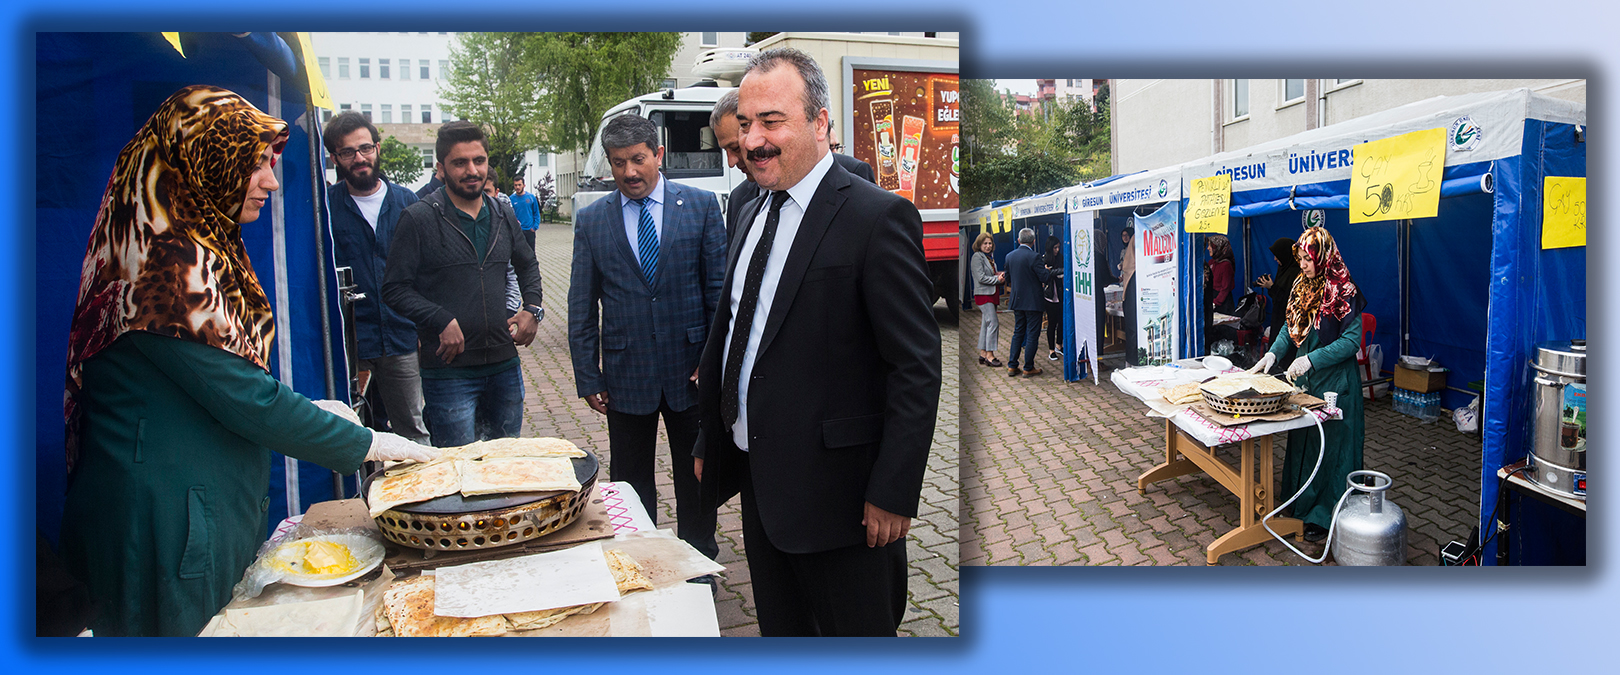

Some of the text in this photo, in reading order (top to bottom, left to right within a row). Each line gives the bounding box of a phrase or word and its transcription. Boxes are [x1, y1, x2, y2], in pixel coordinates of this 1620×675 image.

[863, 74, 890, 91] YENİ
[1361, 153, 1393, 184] ÇAY
[1082, 186, 1152, 208] GİRESUN ÜNİVERSİTESİ
[1362, 182, 1394, 217] 50
[1573, 201, 1586, 216] 50
